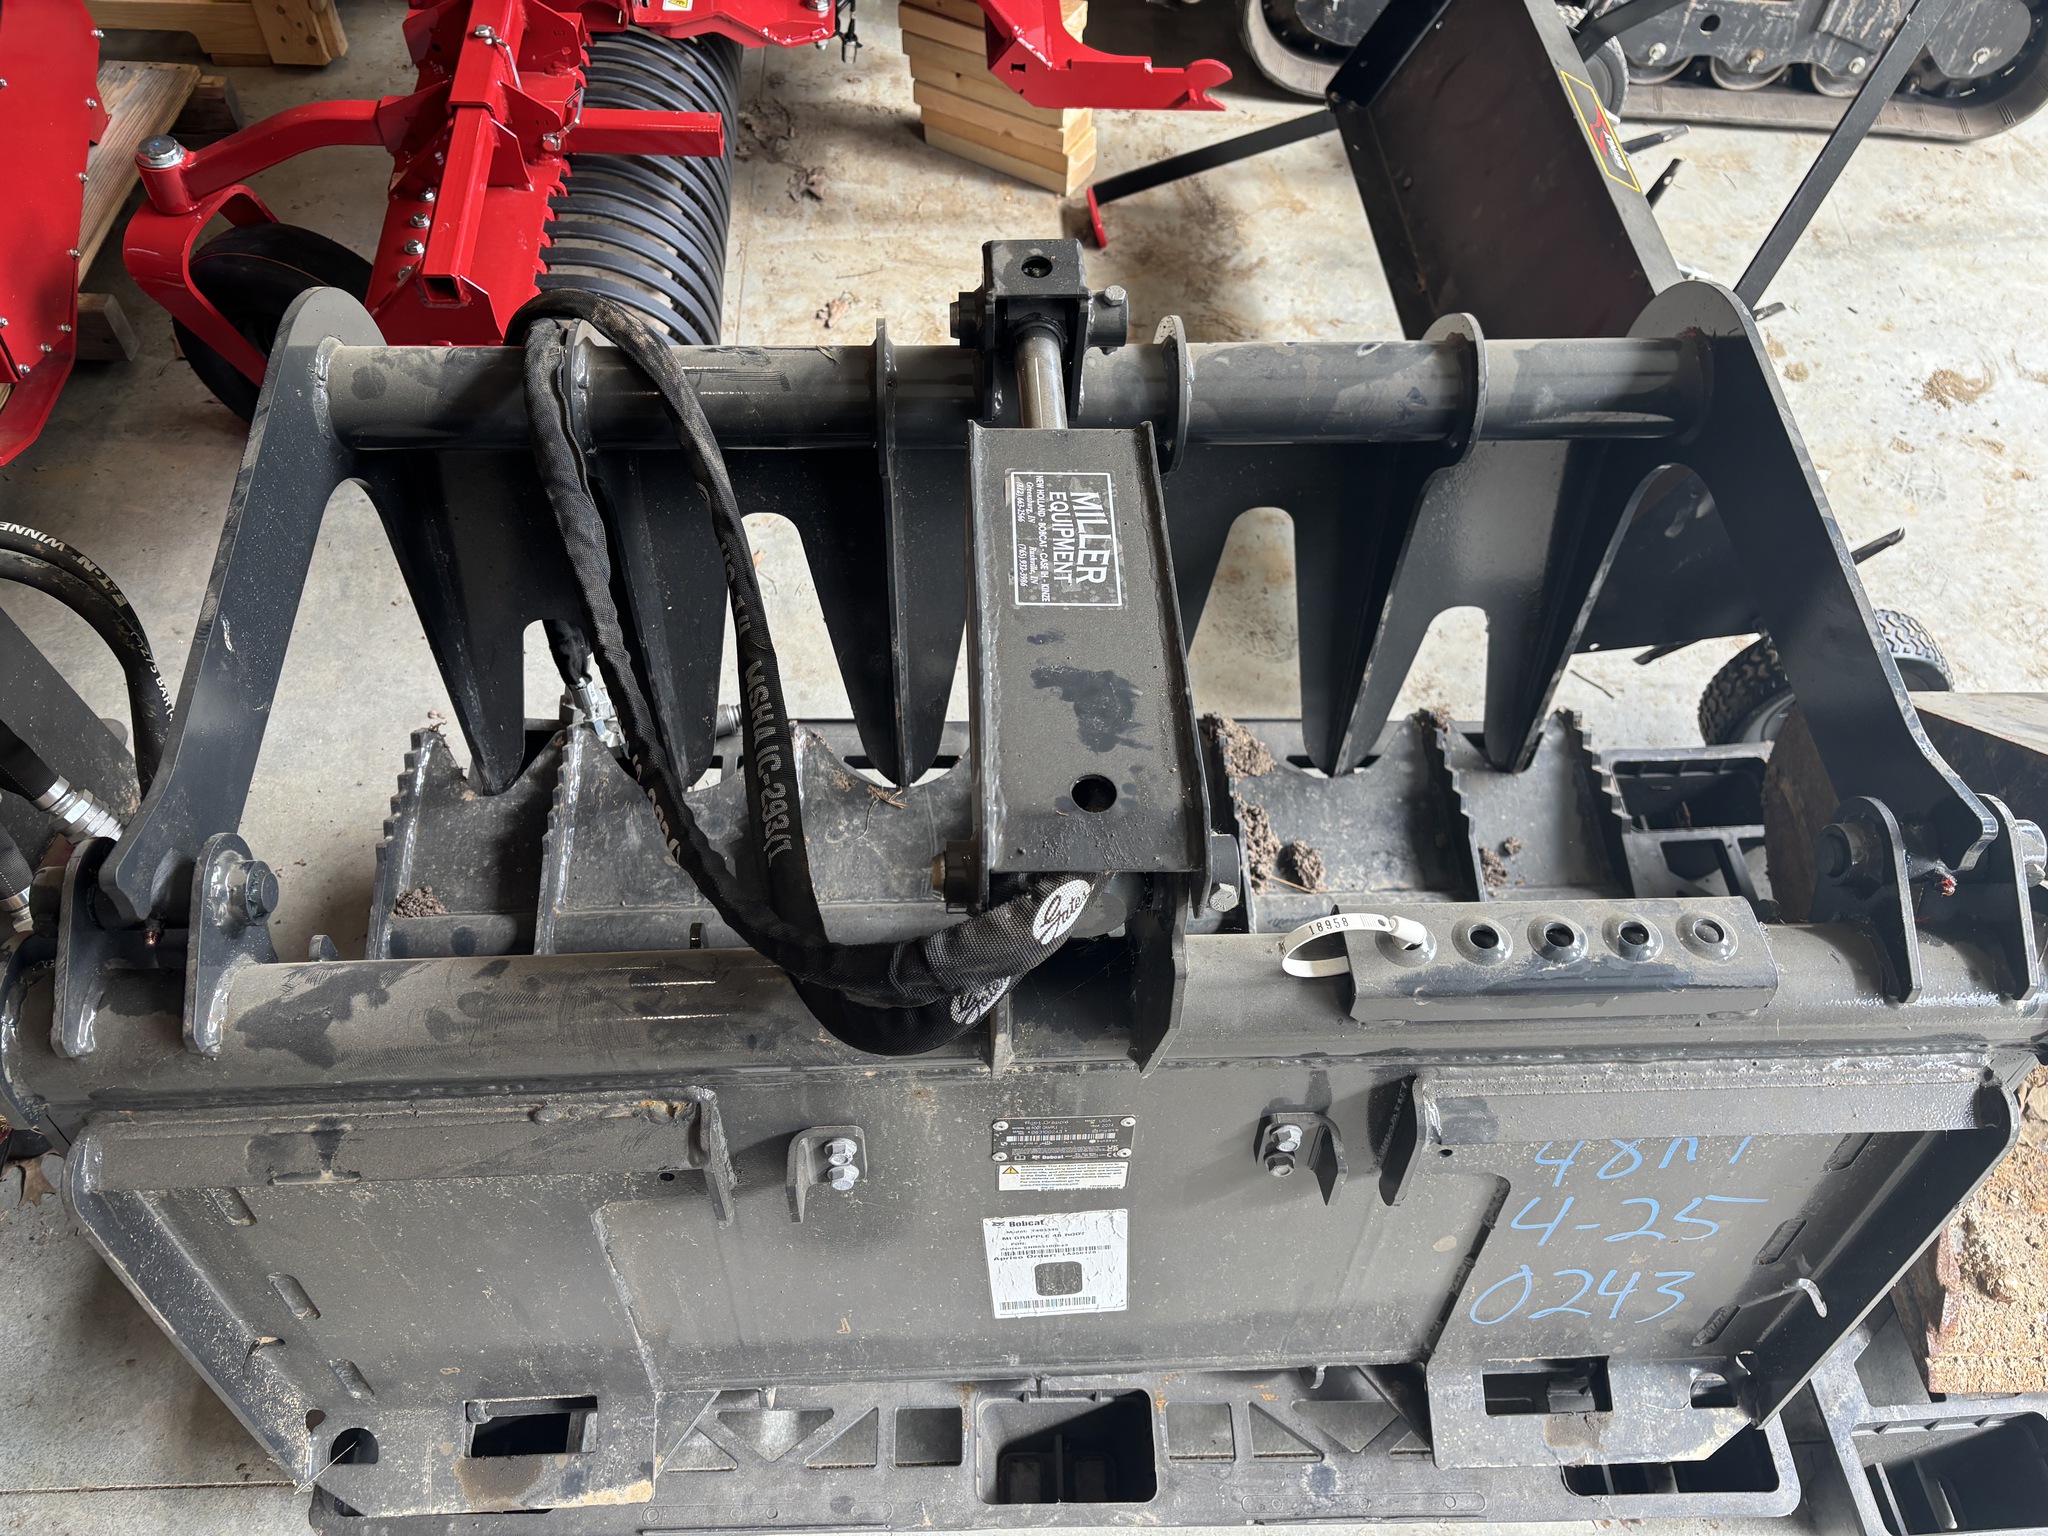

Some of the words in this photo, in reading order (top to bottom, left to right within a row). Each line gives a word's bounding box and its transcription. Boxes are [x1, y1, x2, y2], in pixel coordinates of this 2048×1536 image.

[1036, 476, 1044, 487] NEW
[1026, 482, 1034, 514] Greensburg,
[1036, 490, 1045, 517] HOLLAND
[1028, 515, 1035, 523] IN
[1038, 523, 1047, 547] BOBCAT
[1048, 491, 1075, 586] EQUIPMENT
[1070, 492, 1111, 584] MILLER
[1018, 544, 1026, 558] (765)
[1028, 546, 1037, 574] Rushville,
[1039, 553, 1048, 569] CASE
[1030, 576, 1038, 584] IN
[1041, 584, 1050, 602] KINZE
[744, 659, 777, 750] MSHA
[1033, 892, 1092, 946] Gates
[1308, 917, 1349, 935] 18958
[1009, 1220, 1045, 1228] Bobcat
[1510, 1194, 1769, 1247] 4-25
[1469, 1264, 1697, 1326] 0243
